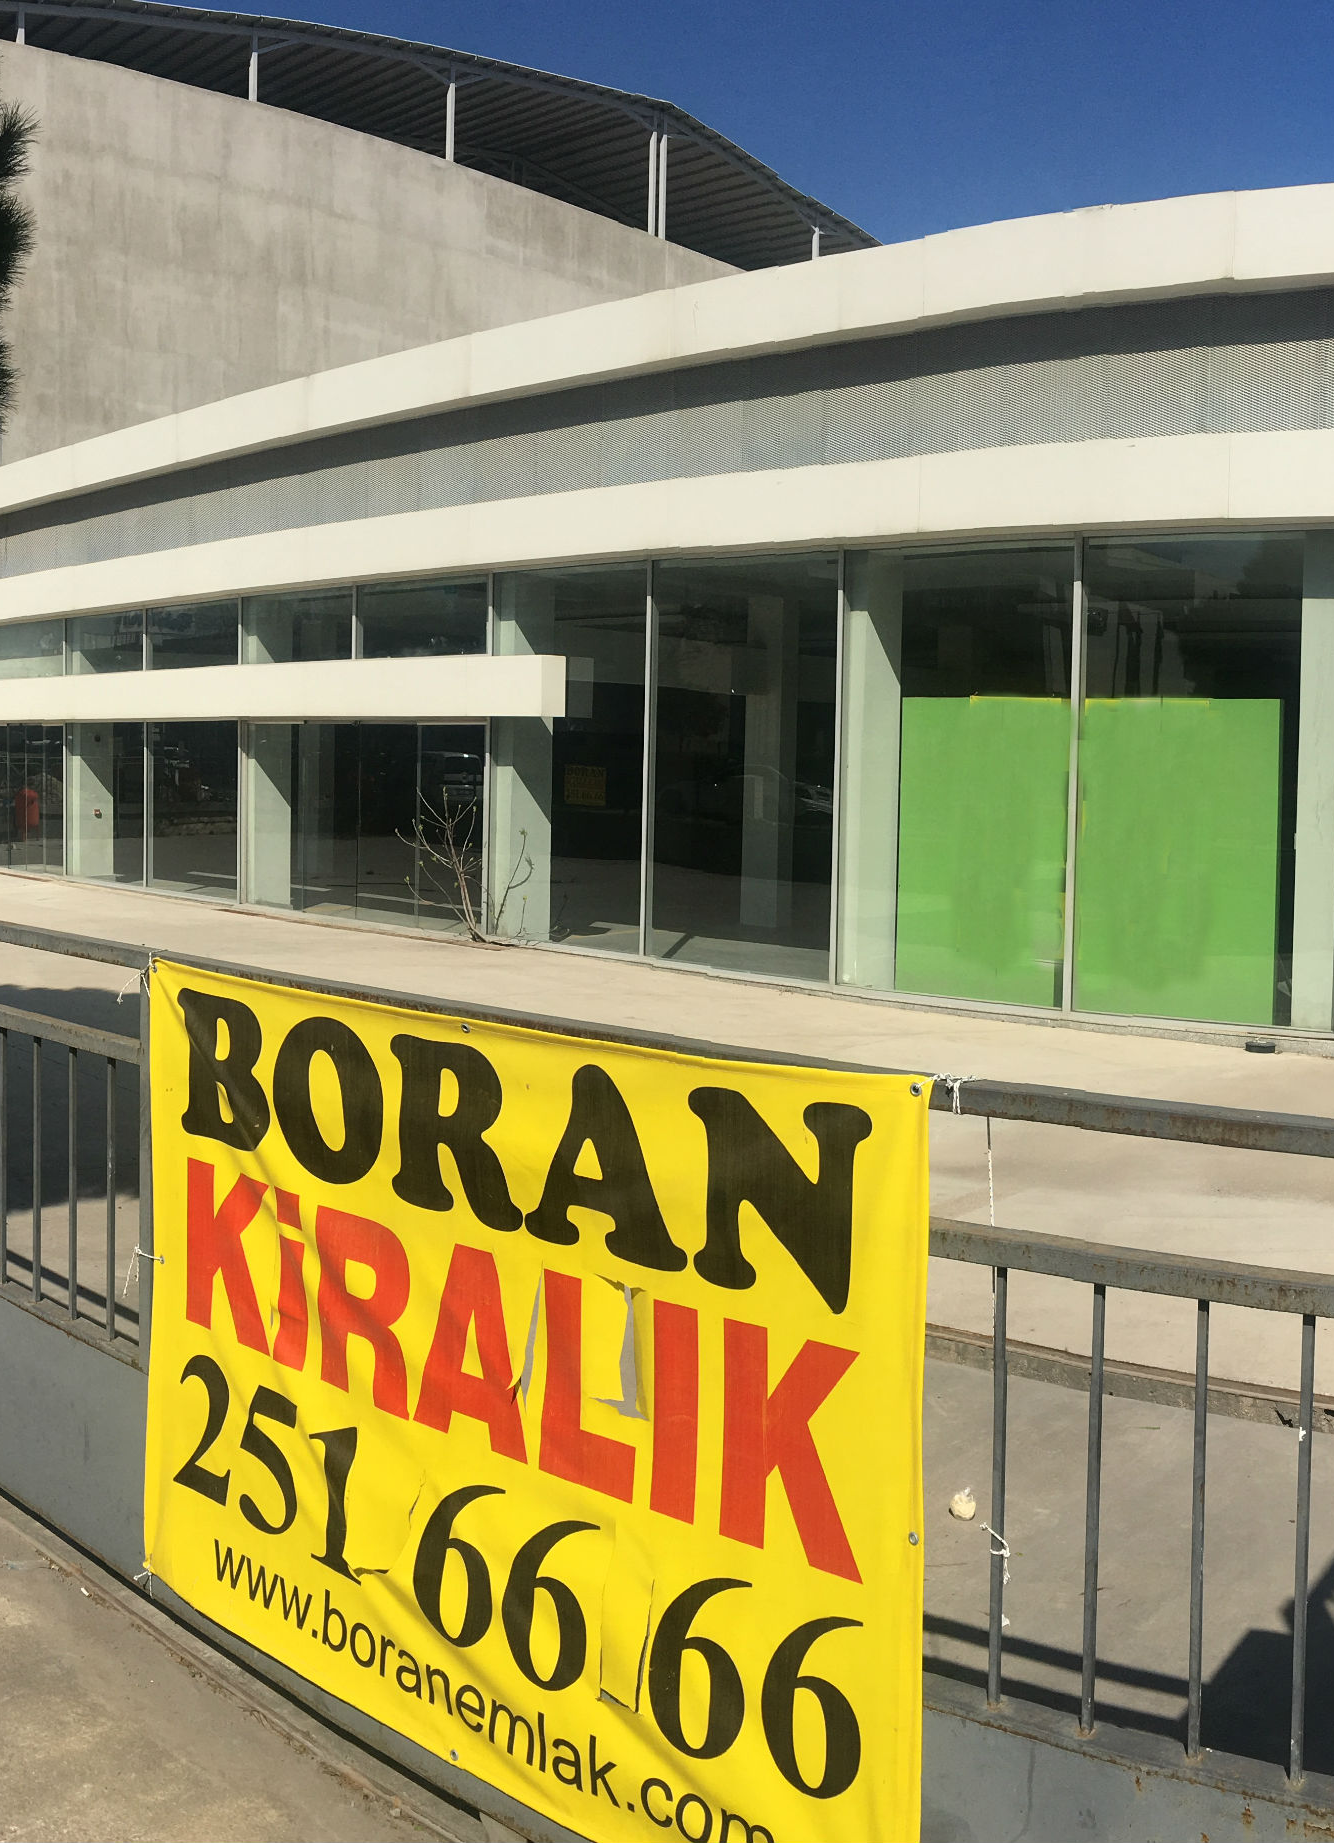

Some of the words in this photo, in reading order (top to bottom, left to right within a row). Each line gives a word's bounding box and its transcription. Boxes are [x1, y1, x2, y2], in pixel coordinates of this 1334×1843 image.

[178, 988, 872, 1314] BORAN
[172, 1354, 365, 1584] 251
[413, 1484, 601, 1691] 66
[648, 1577, 864, 1799] 66
[213, 1538, 774, 1843] www.boranemlak.com
